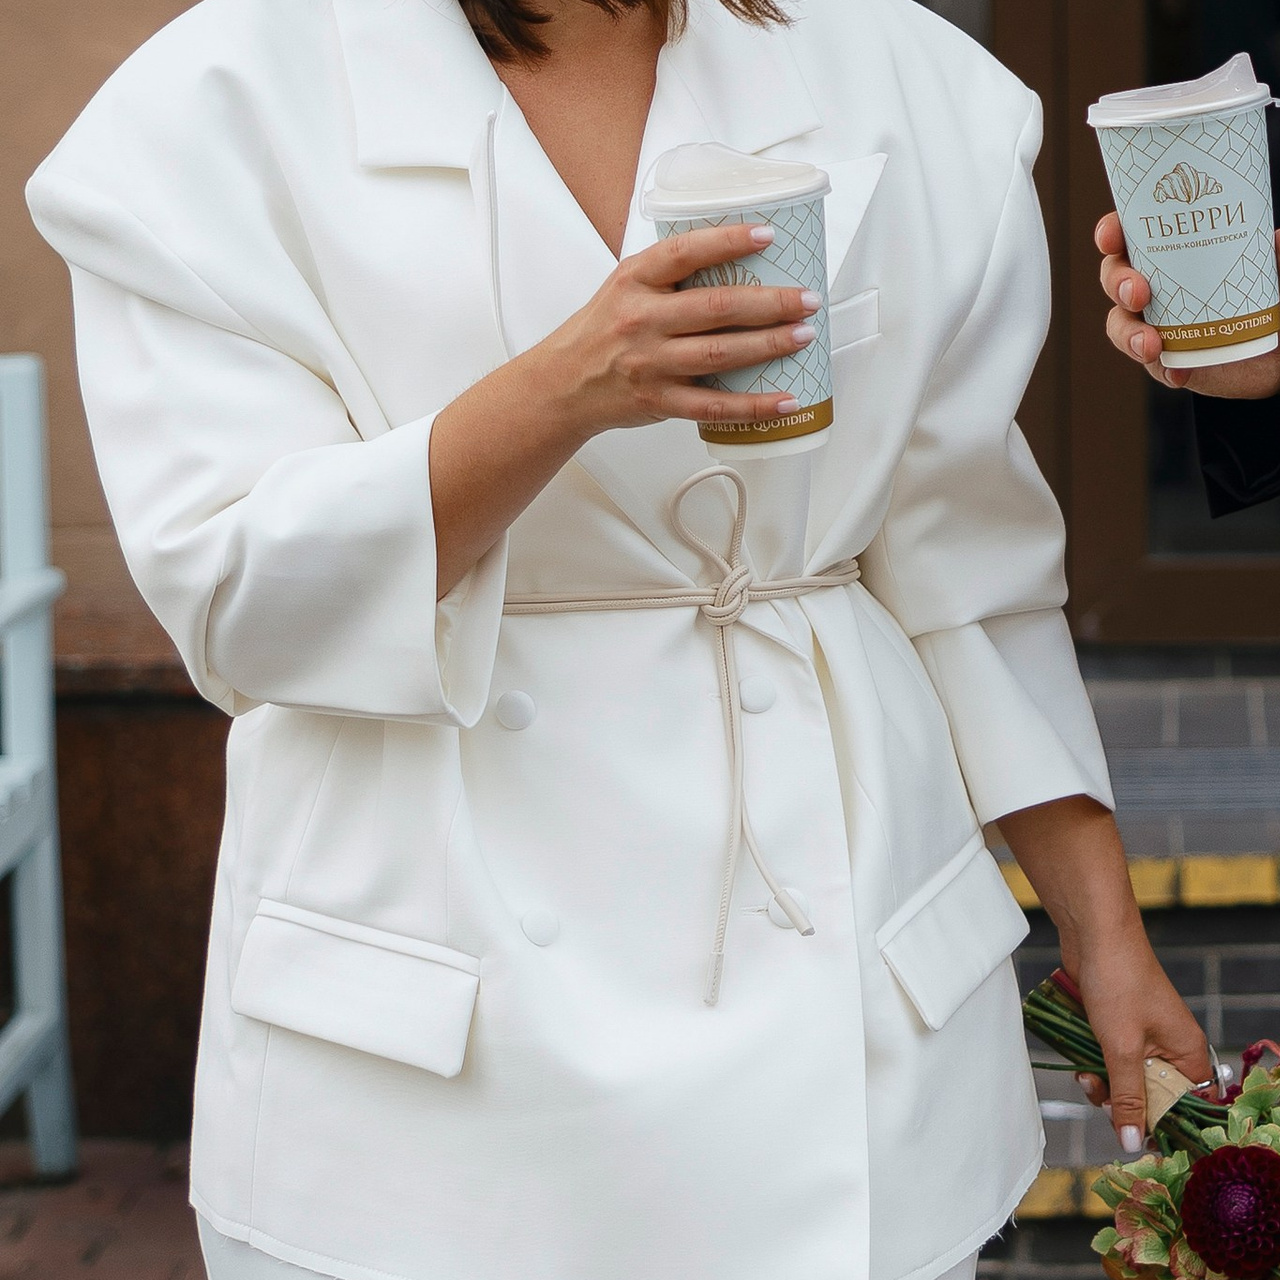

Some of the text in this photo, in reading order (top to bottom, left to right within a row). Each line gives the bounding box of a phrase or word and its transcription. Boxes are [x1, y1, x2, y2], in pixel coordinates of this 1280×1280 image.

[1139, 201, 1246, 239] ТЬЕРРИ
[1146, 231, 1248, 253] ПЕКАРНЯ-КОНДИТЕРСКАЯ
[1159, 313, 1273, 340] VOURER LE QUOTIDIEN
[753, 411, 815, 432] QUOTIDIEN
